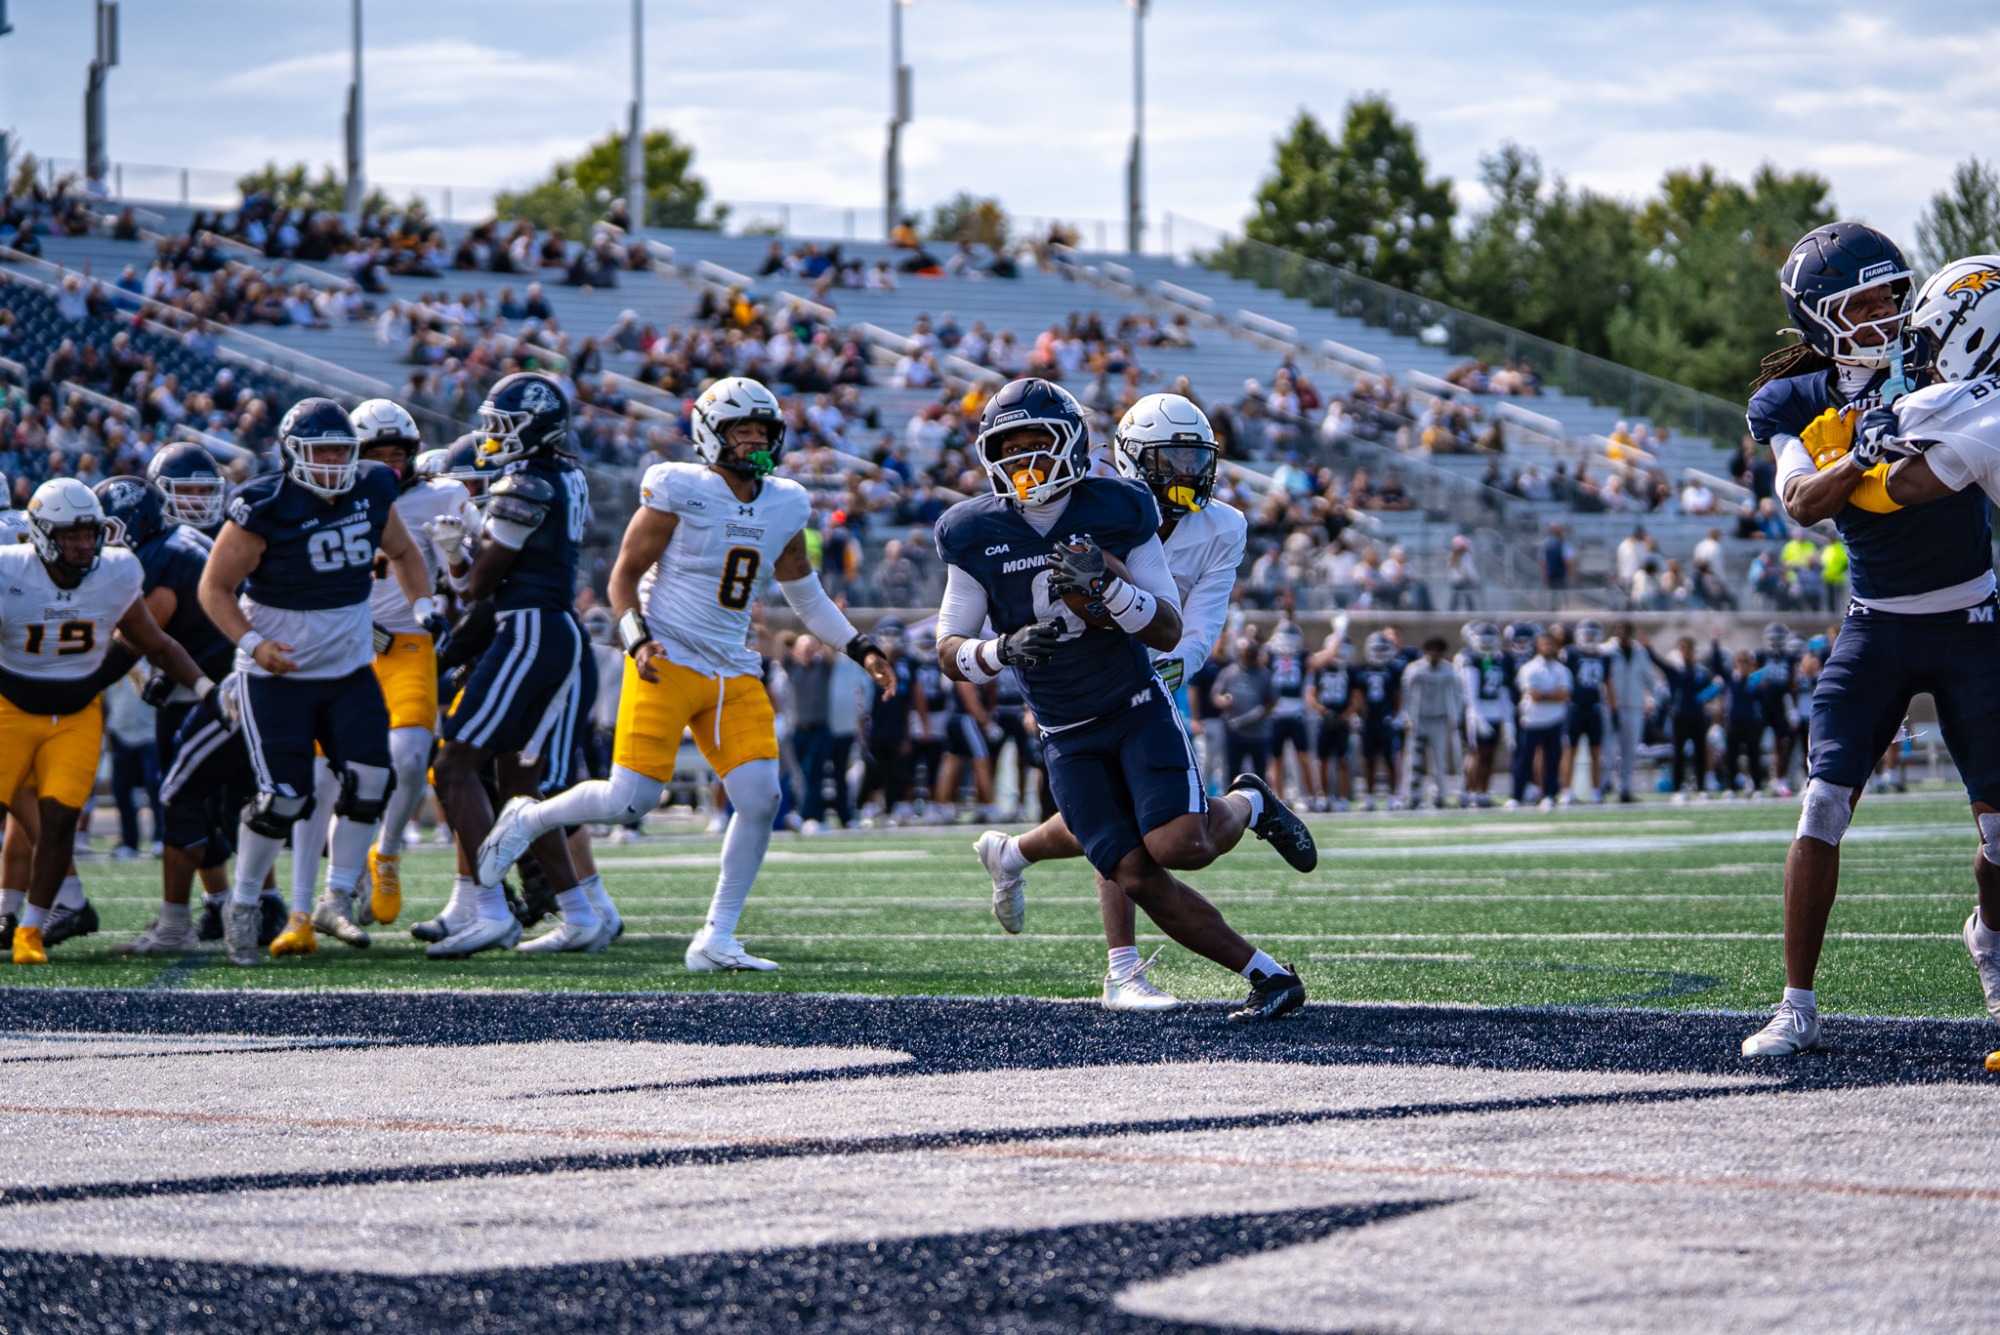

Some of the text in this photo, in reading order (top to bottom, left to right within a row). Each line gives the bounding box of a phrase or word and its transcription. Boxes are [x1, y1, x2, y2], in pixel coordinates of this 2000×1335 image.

[1865, 265, 1893, 278] HAWKS
[997, 412, 1025, 424] HAWKS
[985, 544, 1010, 556] CAA
[718, 546, 761, 611] 8
[1967, 605, 1994, 623] M
[25, 620, 95, 656] 19
